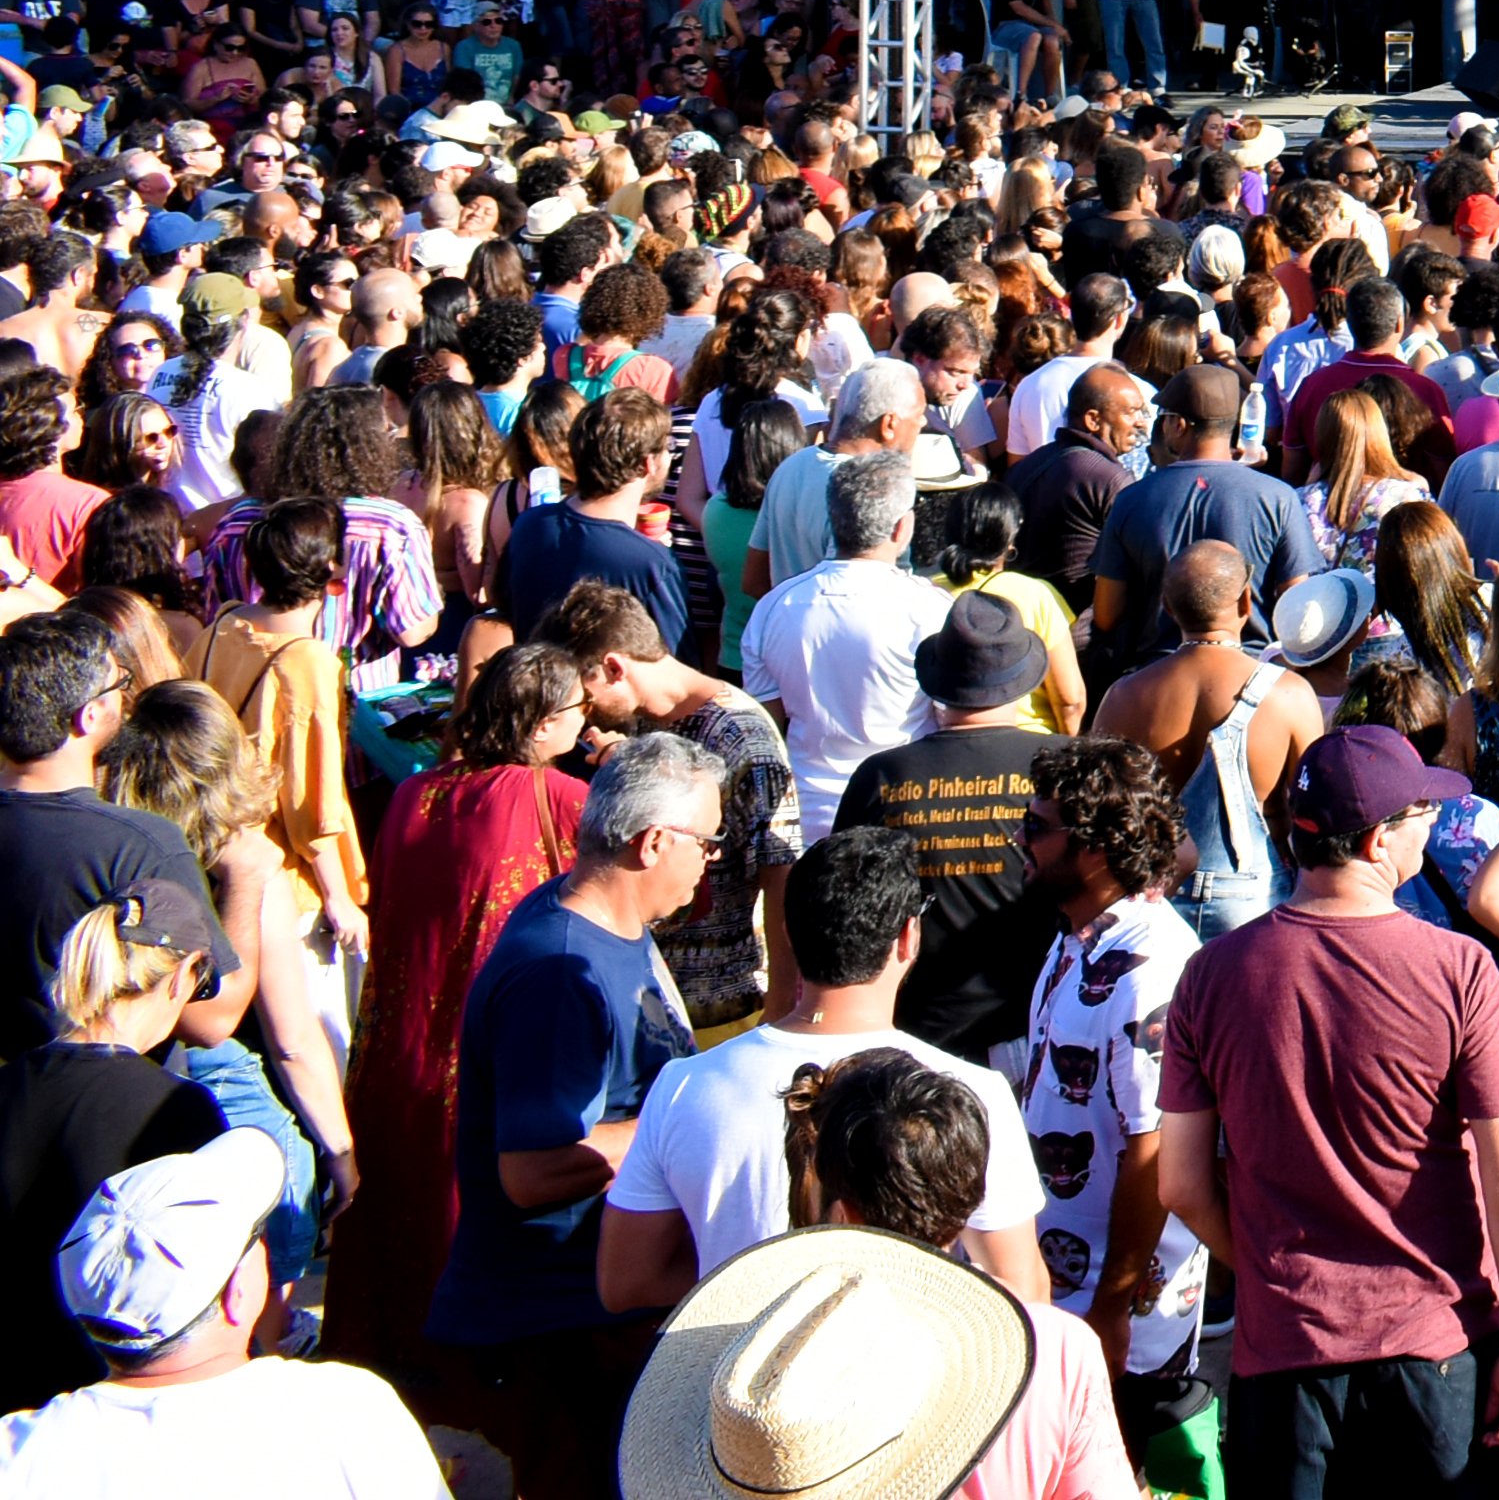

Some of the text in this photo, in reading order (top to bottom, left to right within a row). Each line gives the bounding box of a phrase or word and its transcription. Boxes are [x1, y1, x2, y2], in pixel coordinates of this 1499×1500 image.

[928, 773, 1005, 799] Pinheiral
[929, 808, 956, 824] Metal
[964, 806, 990, 822] Brasil
